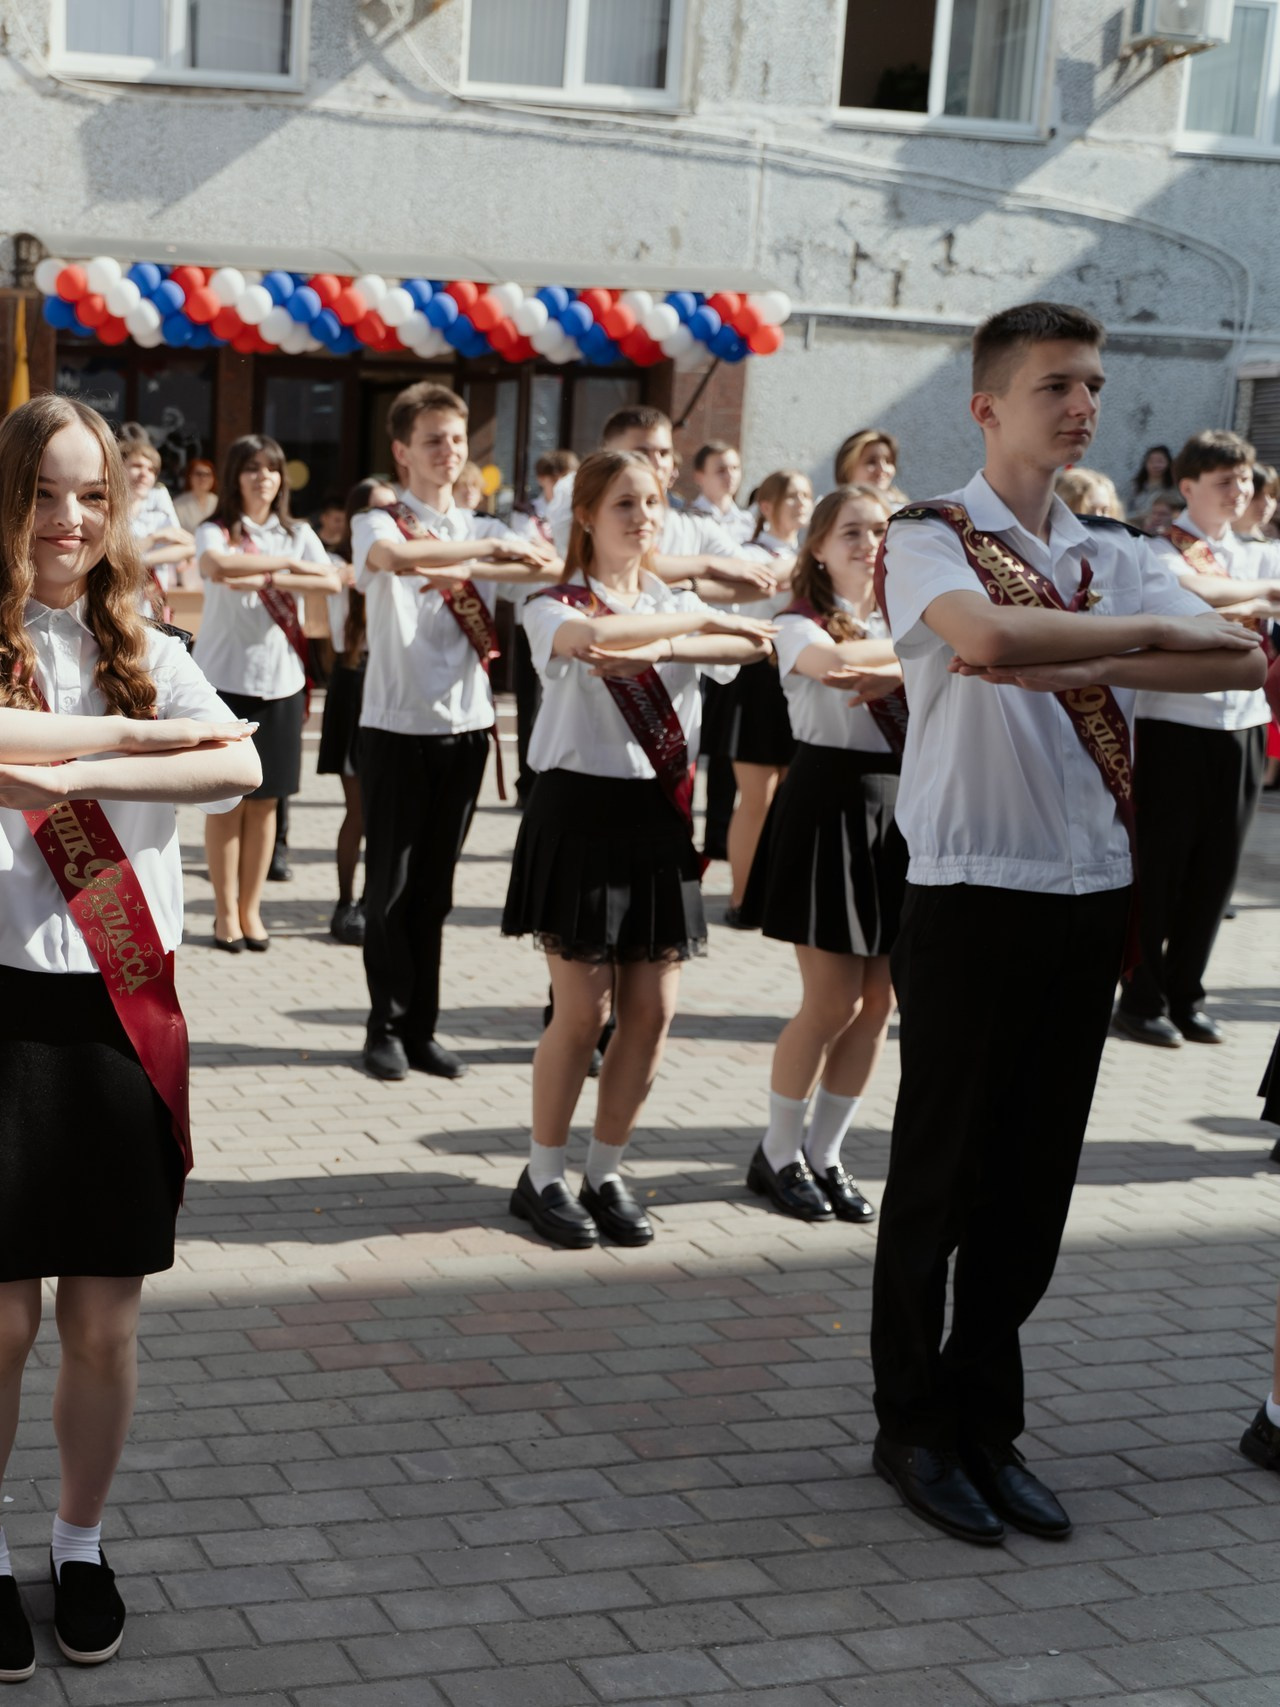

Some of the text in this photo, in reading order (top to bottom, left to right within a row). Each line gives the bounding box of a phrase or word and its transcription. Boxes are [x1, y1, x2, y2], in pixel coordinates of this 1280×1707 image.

[1065, 684, 1107, 713] 9
[63, 858, 123, 892] 9
[88, 886, 150, 996] КЛАССА
